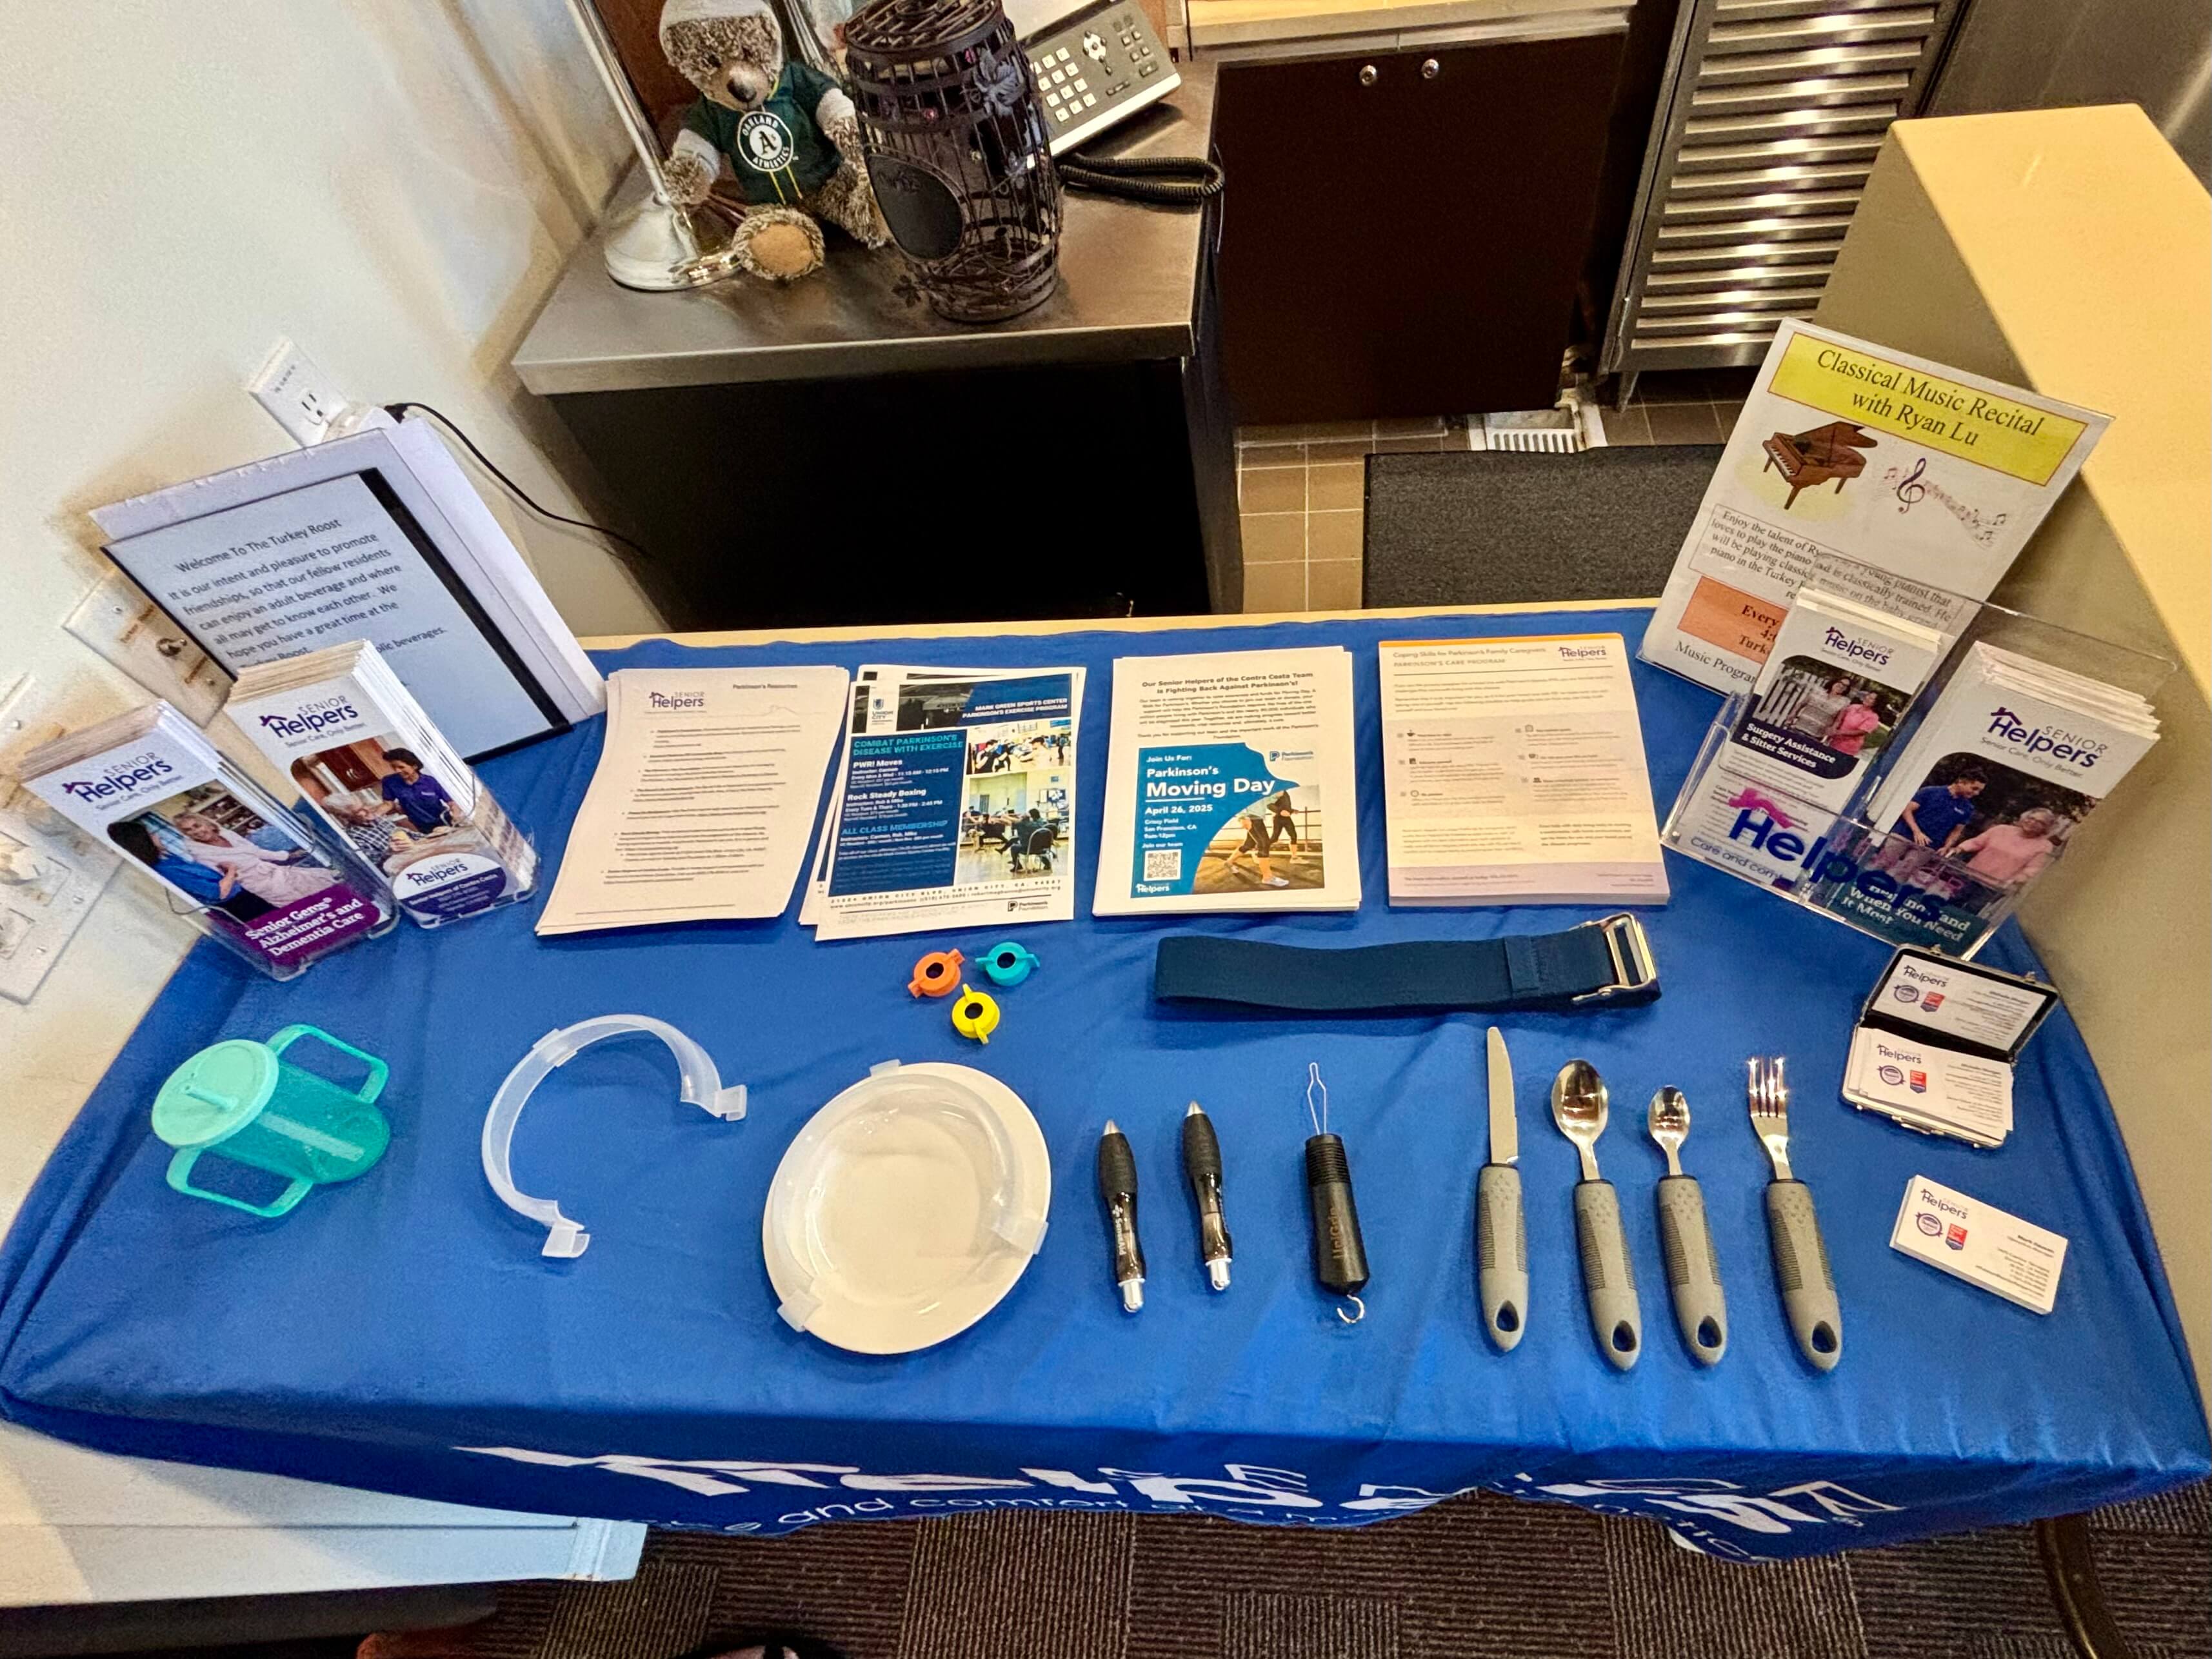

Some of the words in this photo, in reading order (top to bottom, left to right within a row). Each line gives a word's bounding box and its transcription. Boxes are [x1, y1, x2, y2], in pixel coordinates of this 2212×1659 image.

[742, 115, 778, 136] OAKLAND
[752, 146, 790, 168] ATHLETICS
[1817, 350, 1902, 391] Classical
[1903, 377, 1964, 411] Music
[1968, 397, 2045, 436] Recital
[1852, 392, 1889, 418] with
[1895, 404, 1946, 435] Ryan
[1949, 421, 1978, 446] Lu
[1711, 518, 1735, 535] loves
[1737, 530, 1746, 539] to
[1746, 535, 1767, 549] play
[1769, 543, 1784, 554] the
[1784, 550, 1811, 565] piano
[1723, 510, 1750, 529] Enjoy
[1751, 523, 1767, 535] the
[1767, 530, 1795, 546] talent
[1795, 542, 1808, 551] of
[174, 551, 232, 572] Welcome
[228, 547, 247, 556] To
[245, 541, 270, 551] The
[268, 529, 308, 545] Turkey
[307, 519, 342, 534] Roost
[1712, 533, 1730, 546] will
[1731, 539, 1742, 550] be
[1742, 546, 1778, 566] playing
[191, 582, 211, 593] our
[212, 571, 248, 588] intent
[248, 564, 270, 577] and
[270, 551, 317, 572] pleasure
[317, 548, 330, 556] to
[332, 533, 379, 554] promote
[1710, 547, 1735, 562] piano
[1737, 557, 1747, 566] in
[1748, 561, 1763, 573] the
[1765, 567, 1796, 587] Turkey
[182, 593, 250, 615] friendships,
[249, 588, 263, 596] so
[263, 579, 288, 592] that
[288, 573, 308, 584] our
[306, 564, 342, 579] fellow
[343, 549, 392, 568] residents
[199, 619, 221, 630] can
[221, 610, 252, 622] enjoy
[252, 605, 268, 614] an
[267, 595, 298, 610] adult
[295, 581, 346, 601] beverage
[346, 573, 368, 586] and
[367, 564, 401, 580] where
[215, 634, 228, 644] all
[228, 628, 254, 641] may
[253, 622, 274, 635] get
[272, 618, 285, 626] to
[284, 609, 316, 622] know
[317, 600, 343, 613] each
[377, 584, 397, 594] We
[1741, 604, 1779, 628] Every
[226, 645, 256, 659] hope
[256, 638, 278, 651] you
[277, 630, 305, 643] have
[314, 618, 343, 634] great
[342, 611, 368, 624] time
[368, 607, 381, 616] at
[379, 601, 399, 612] the
[392, 626, 448, 648] beverages.
[1561, 648, 1606, 658] Helpers
[1675, 641, 1711, 664] Music
[1825, 633, 1889, 665] Helpers
[1858, 637, 1894, 654] SENIOR
[297, 695, 348, 715] SENIOR
[652, 696, 704, 710] Helpers
[1017, 700, 1042, 708] SPORTS
[1042, 697, 1068, 706] CENTER
[269, 705, 358, 738] Helpers
[853, 747, 893, 756] DISEASE
[894, 745, 918, 753] WITH
[920, 741, 964, 751] EXERCISE
[854, 739, 895, 748] COMBAT
[896, 734, 958, 745] PARKINSON'S
[1742, 733, 1749, 741] &
[1749, 736, 1777, 751] Sitter
[1777, 746, 1817, 768] Services
[1747, 723, 1785, 743] Surgery
[1784, 739, 1836, 764] Assistance
[1988, 717, 2098, 768] Helpers
[2042, 726, 2108, 754] SENIOR
[104, 752, 159, 776] SENIOR
[1146, 766, 1219, 778] Parkinson's
[2032, 756, 2053, 768] Only
[75, 760, 172, 802] Helpers
[1146, 780, 1226, 798] Moving
[1233, 778, 1275, 795] Day
[869, 791, 898, 799] Steady
[1144, 806, 1168, 815] April
[859, 825, 888, 833] CLASS
[890, 820, 948, 831] MEMBERSHIP
[1691, 838, 1720, 855] Care
[1722, 850, 1749, 867] and
[1729, 809, 1948, 922] Helpers
[413, 863, 468, 886] Helpers
[1137, 884, 1170, 893] Helpers
[245, 917, 292, 940] Senior
[259, 911, 337, 948] Alzheimer's
[335, 898, 364, 915] and
[268, 926, 335, 956] Dementia
[332, 913, 366, 928] Care
[1895, 907, 1922, 924] You
[1924, 921, 1964, 942] Need
[1904, 969, 1948, 988] Helpers
[1879, 1047, 1922, 1064] Helpers
[1922, 1193, 1968, 1219] Helpers
[777, 1498, 894, 1524] and
